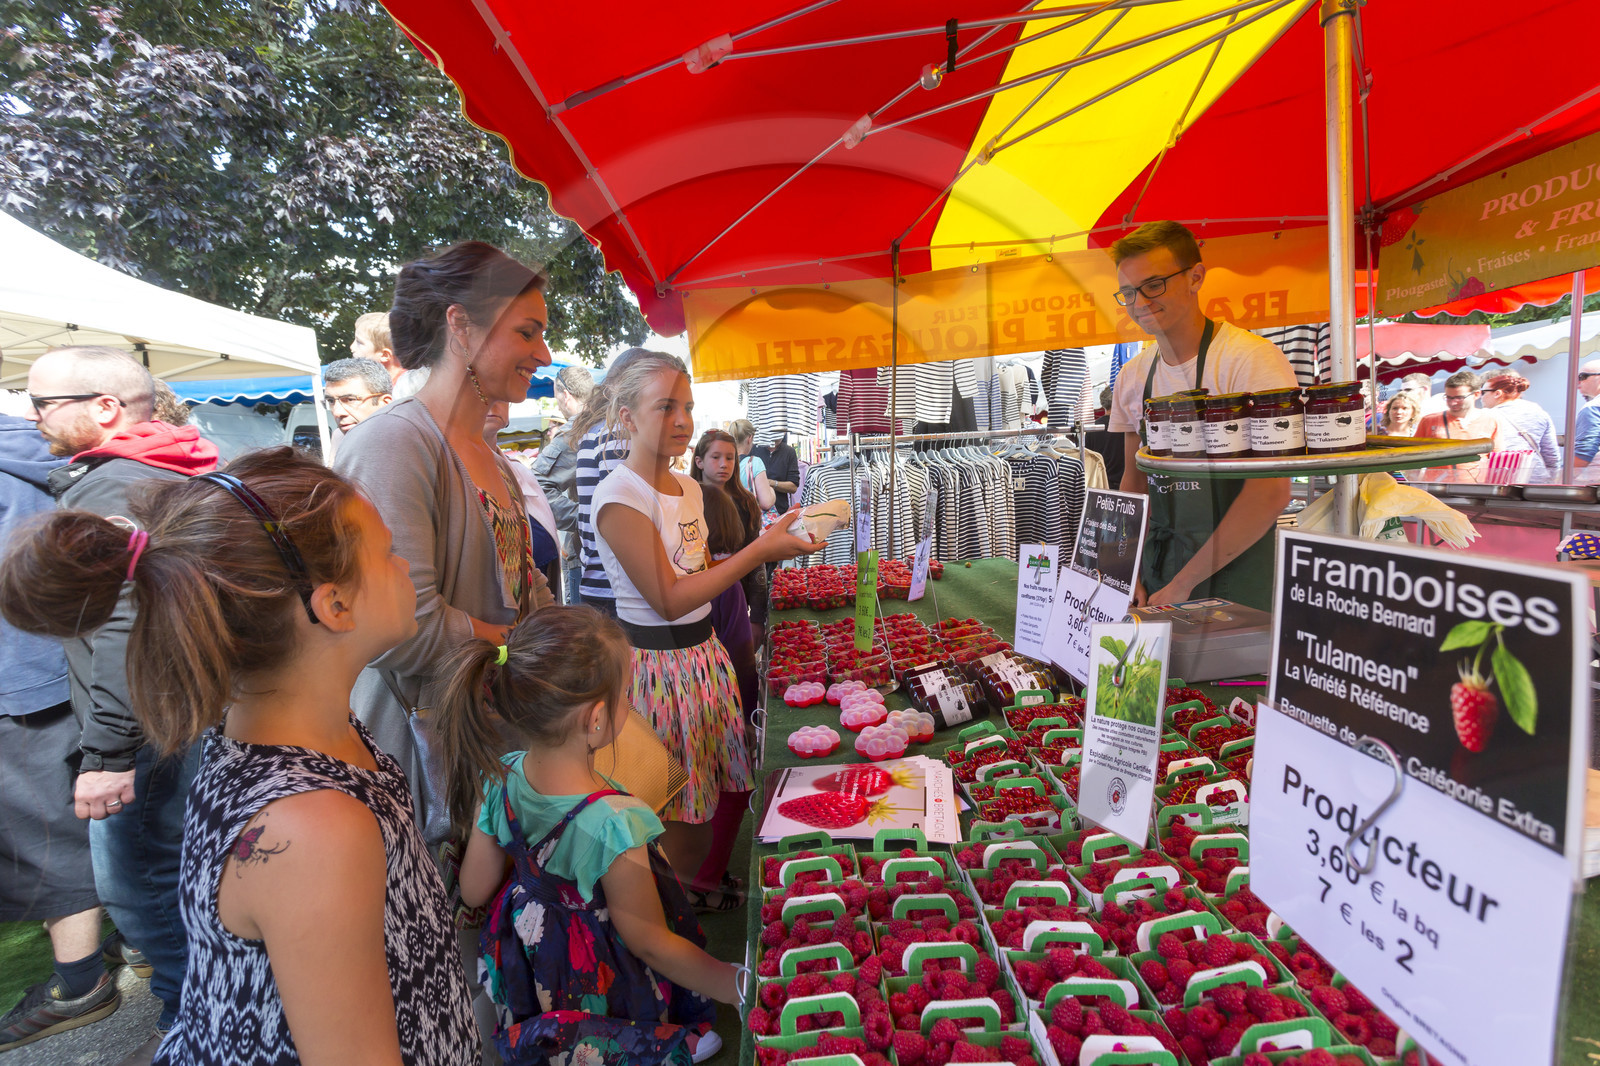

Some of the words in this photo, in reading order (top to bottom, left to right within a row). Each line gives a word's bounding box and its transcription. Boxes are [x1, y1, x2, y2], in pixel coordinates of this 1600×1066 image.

[1385, 273, 1449, 301] Plougastel
[1477, 248, 1531, 274] Fraises
[1095, 495, 1115, 512] Petits
[1115, 498, 1136, 516] Fruits
[1107, 522, 1117, 533] Bois
[1064, 590, 1114, 623] Producteur
[1290, 583, 1305, 602] de
[1308, 587, 1323, 607] La
[1326, 590, 1369, 619] Roche
[1372, 601, 1436, 637] Bernard
[1291, 544, 1560, 636] Framboises
[1066, 632, 1073, 645] 7
[1072, 639, 1078, 649] €
[1067, 613, 1084, 632] 3,60
[1296, 630, 1419, 693] "Tulameen"
[1285, 659, 1300, 681] La
[1302, 664, 1347, 699] Variété
[1350, 684, 1430, 734] Référence
[1091, 715, 1097, 724] La
[1096, 717, 1110, 727] nature
[1110, 720, 1127, 732] protège
[1128, 724, 1137, 732] nos
[1136, 726, 1156, 737] cultures
[1089, 748, 1114, 763] Exploitation
[1113, 756, 1132, 769] Agricole
[1280, 697, 1337, 735] Barquette
[1340, 724, 1357, 746] de
[1407, 757, 1492, 813] Catégorie
[1497, 798, 1556, 843] Extra
[1282, 765, 1500, 923] Producteur
[1306, 828, 1360, 885] 3,60
[1369, 880, 1385, 905] €
[1392, 898, 1408, 922] la
[1414, 914, 1440, 950] bq
[1318, 875, 1332, 904] 7
[1340, 902, 1354, 926] €
[1361, 920, 1385, 951] les
[1395, 938, 1415, 975] 2
